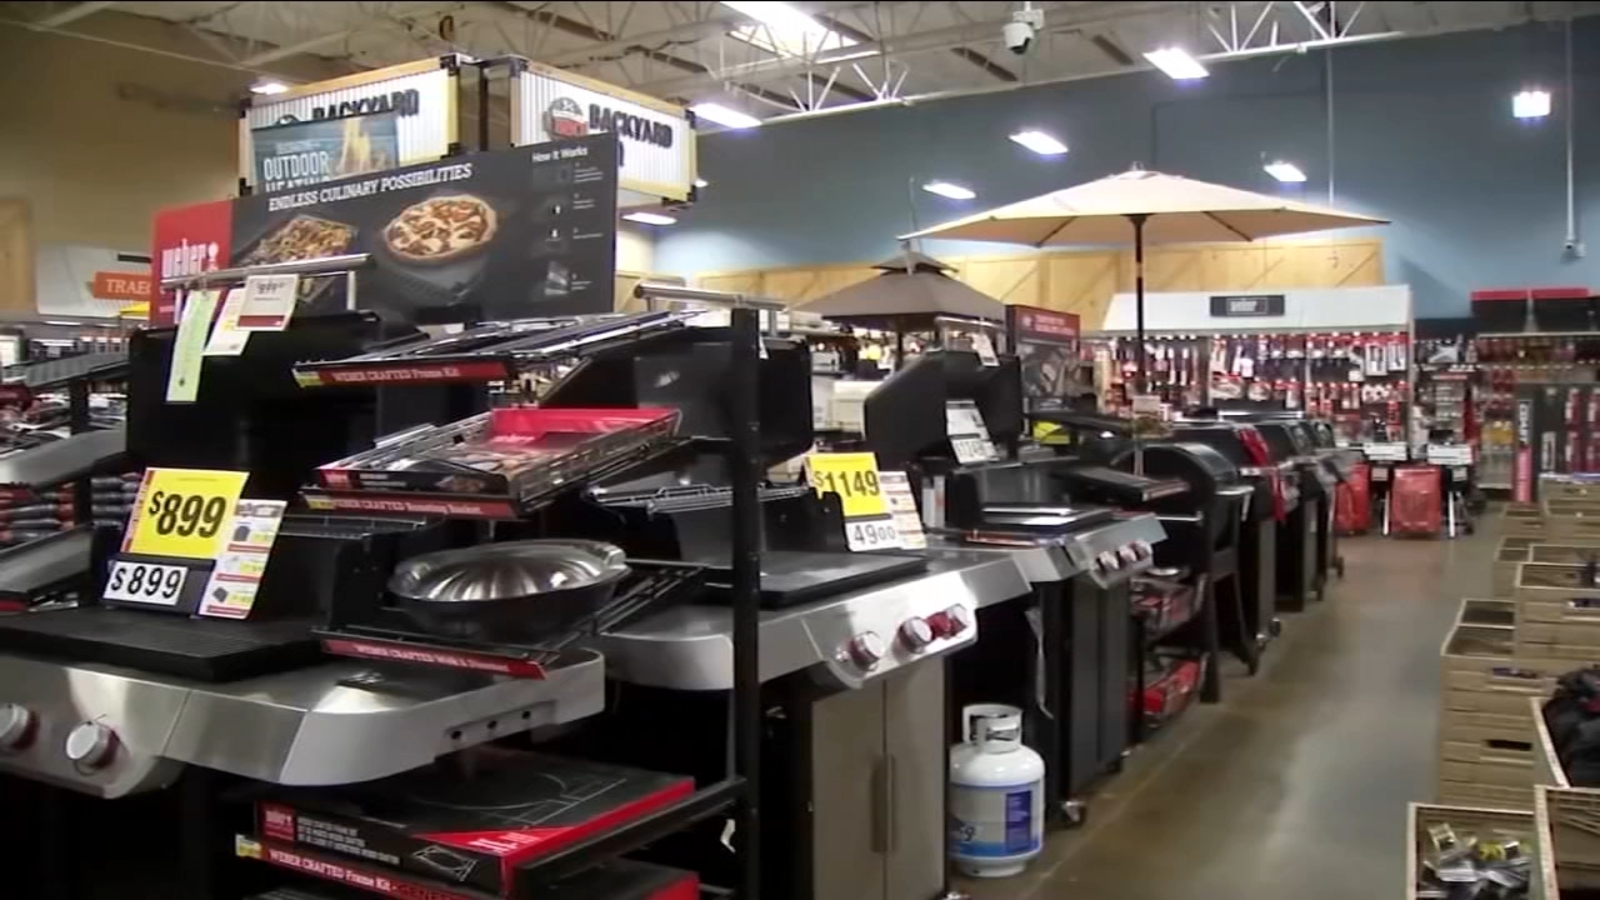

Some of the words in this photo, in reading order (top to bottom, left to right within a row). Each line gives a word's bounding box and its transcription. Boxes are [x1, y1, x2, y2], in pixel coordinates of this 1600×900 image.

[588, 103, 673, 149] BACKYARD
[263, 150, 330, 181] OUTDOOR
[268, 190, 319, 212] ENDLESS
[319, 179, 379, 204] CULINARY
[380, 162, 474, 192] POSSIBILITIES
[813, 469, 881, 498] $1149
[148, 490, 228, 539] $899
[268, 848, 303, 868] WEBER
[302, 857, 344, 879] CRAFTED
[344, 869, 375, 887] Frame
[375, 878, 392, 892] Kit
